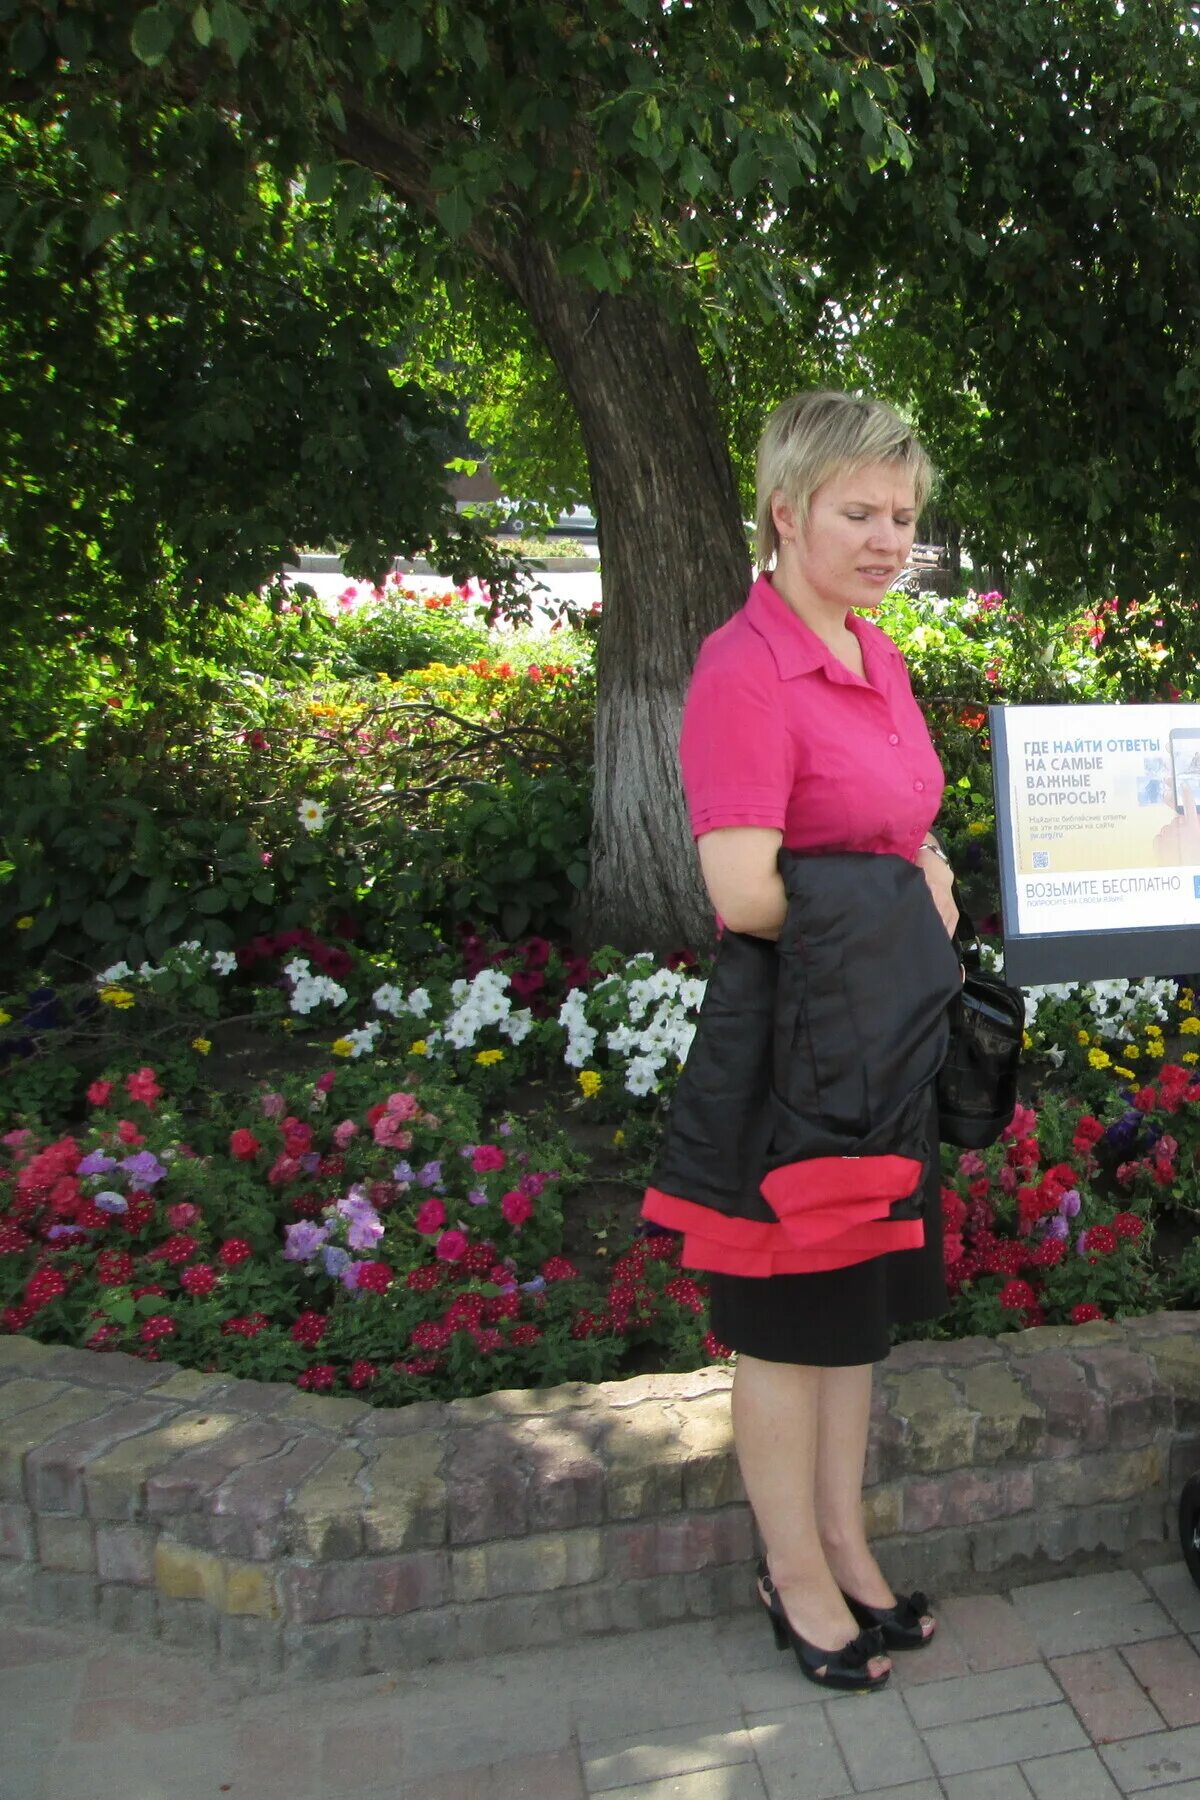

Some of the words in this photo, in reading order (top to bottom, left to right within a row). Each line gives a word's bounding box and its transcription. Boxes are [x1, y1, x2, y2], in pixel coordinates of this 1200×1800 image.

[1024, 741, 1049, 757] ГДЕ
[1053, 738, 1102, 752] НАЙТИ
[1106, 739, 1160, 752] ОТВЕТЫ
[1025, 758, 1046, 771] НА
[1051, 757, 1103, 770] САМЫЕ
[1026, 774, 1091, 789] ВАЖНЫЕ
[1028, 791, 1106, 806] ВОПРОСЫ?
[1054, 824, 1082, 832] вопросы
[1026, 880, 1098, 898] ВОЗЬМИТЕ
[1102, 876, 1181, 894] БЕСПЛАТНО
